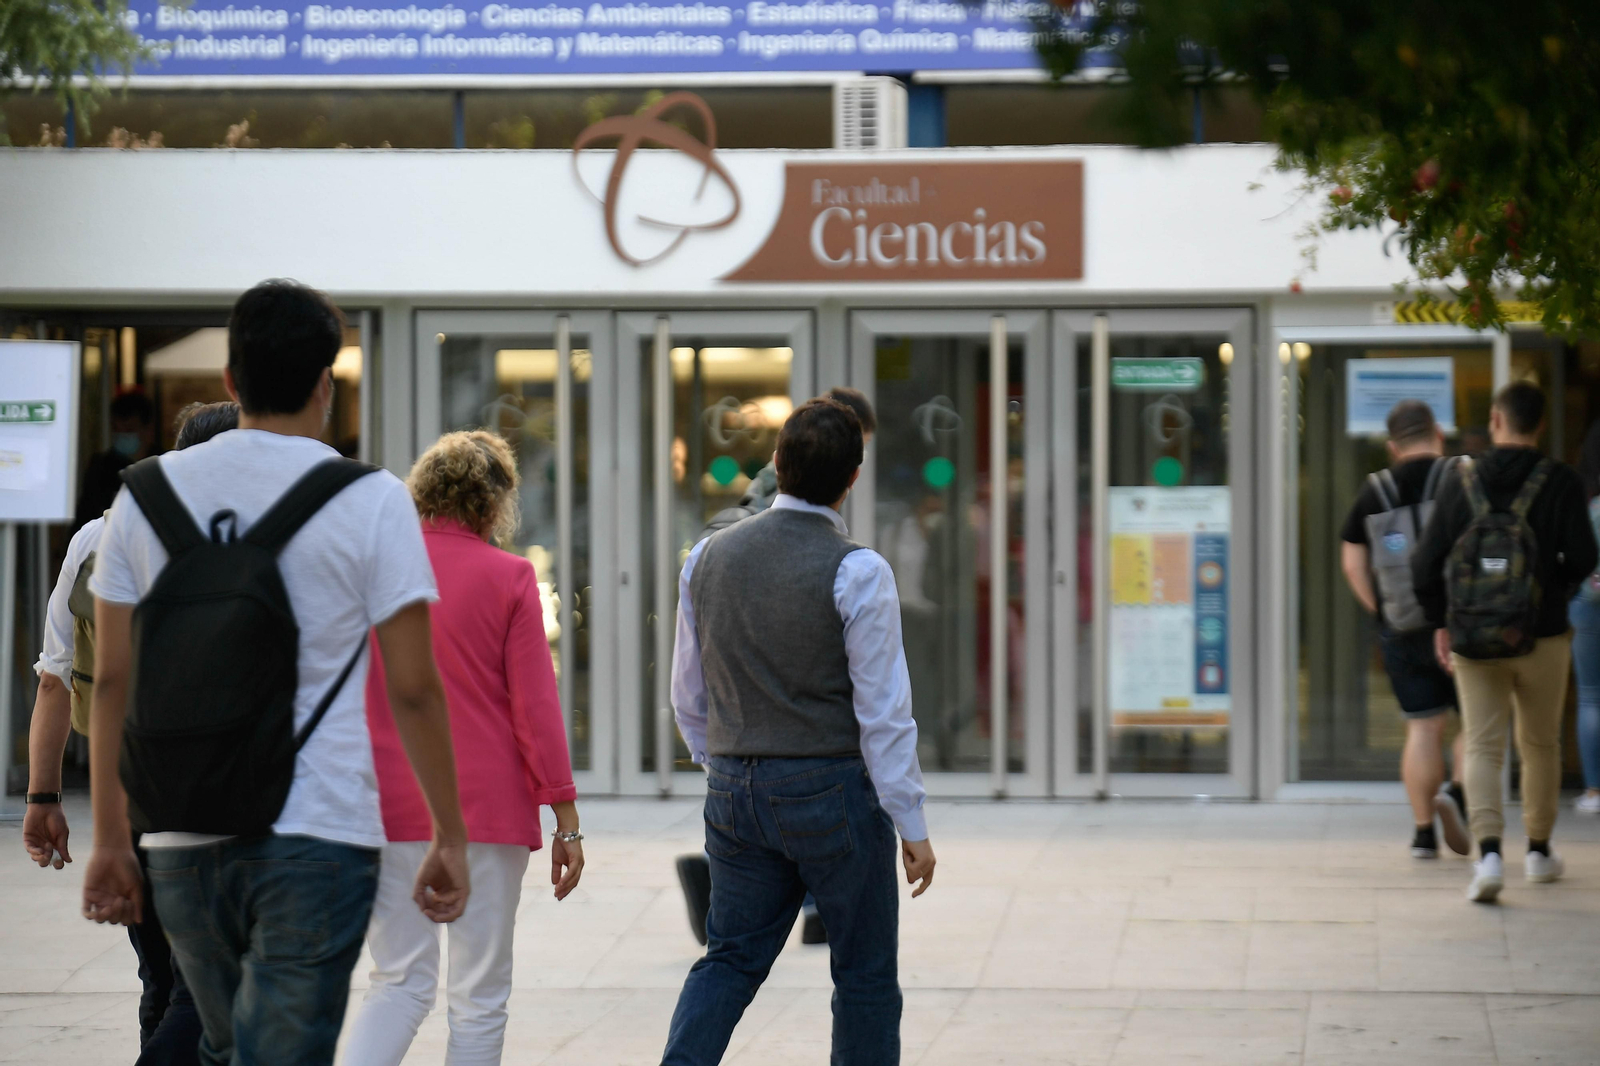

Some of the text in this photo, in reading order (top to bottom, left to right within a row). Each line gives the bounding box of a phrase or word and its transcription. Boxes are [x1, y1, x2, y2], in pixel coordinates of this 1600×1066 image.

[156, 4, 289, 33] Bioquímica
[304, 4, 467, 34] Biotecnología
[480, 3, 585, 30] Ciencias
[585, 3, 732, 28] Ambientales
[747, 0, 879, 26] Estadística
[174, 34, 287, 60] Industrial
[302, 33, 420, 63] Ingeniería
[420, 32, 554, 59] Informática
[555, 36, 574, 63] y
[575, 31, 724, 57] Matemáticas
[738, 30, 857, 60] Ingeniería
[858, 28, 959, 54] Química
[810, 176, 920, 206] Facultad
[809, 206, 1047, 268] Ciencias
